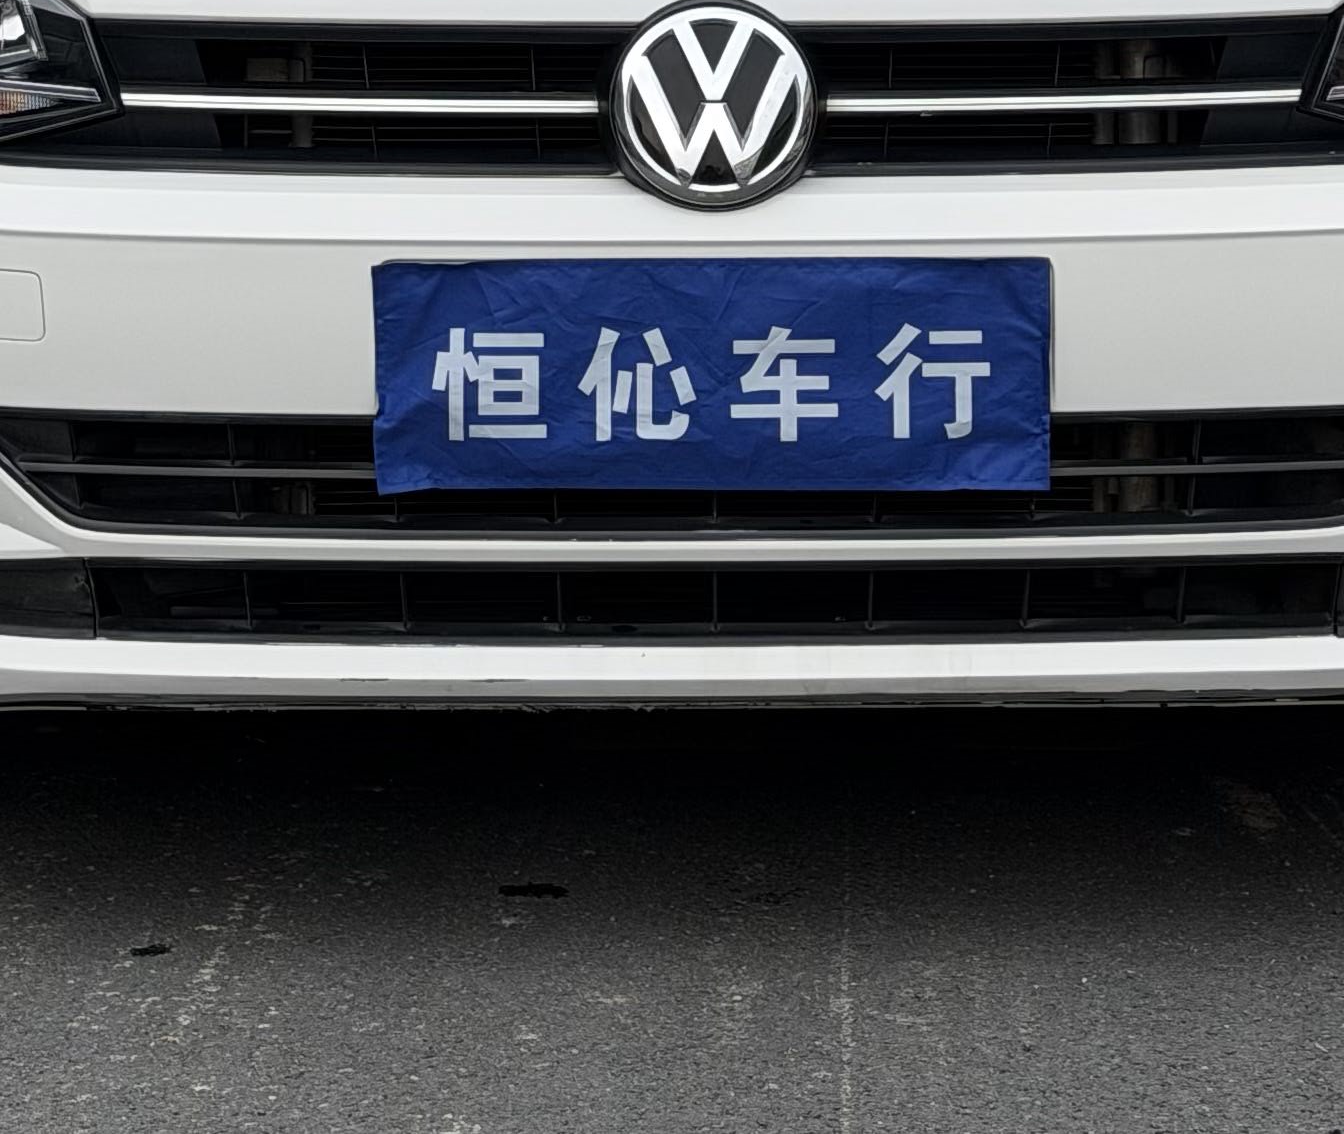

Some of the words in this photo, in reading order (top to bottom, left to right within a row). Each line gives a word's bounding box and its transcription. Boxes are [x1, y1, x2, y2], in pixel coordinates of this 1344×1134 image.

[620, 7, 810, 193] VW
[432, 323, 992, 442] 恒伈车行
